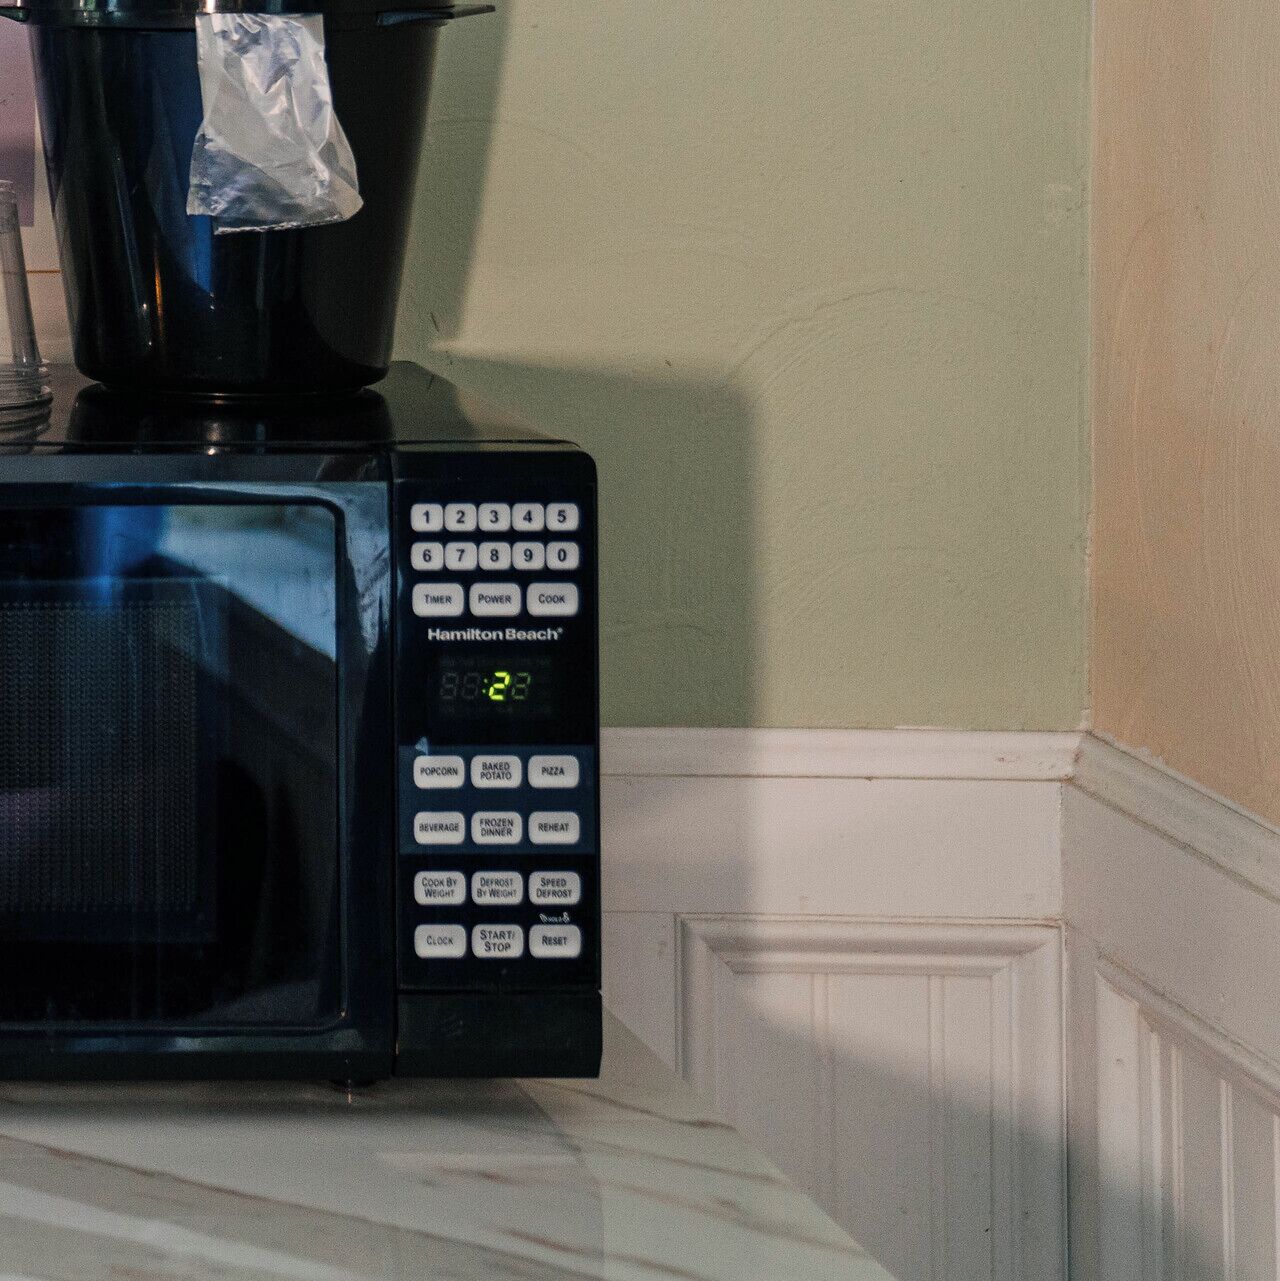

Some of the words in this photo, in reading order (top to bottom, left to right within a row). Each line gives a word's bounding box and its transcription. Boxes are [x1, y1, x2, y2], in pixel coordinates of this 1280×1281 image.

[422, 510, 430, 524] 1
[456, 510, 466, 524] 2
[489, 510, 499, 524] 3
[523, 510, 533, 524] 4
[557, 510, 567, 524] 5
[422, 548, 432, 562] 6
[455, 548, 465, 562] 7
[490, 548, 499, 562] 8
[523, 548, 533, 562] 9
[557, 548, 567, 562] 0
[428, 628, 503, 641] Hamilton
[420, 767, 458, 777] POPCORN
[481, 762, 511, 771] BAKED
[541, 767, 565, 776] PIZZA
[480, 771, 512, 781] POTATO
[419, 823, 459, 832] BEVERAGE
[480, 818, 514, 827] FROZEN
[538, 823, 569, 832] REHEAT
[481, 827, 512, 837] DINNER
